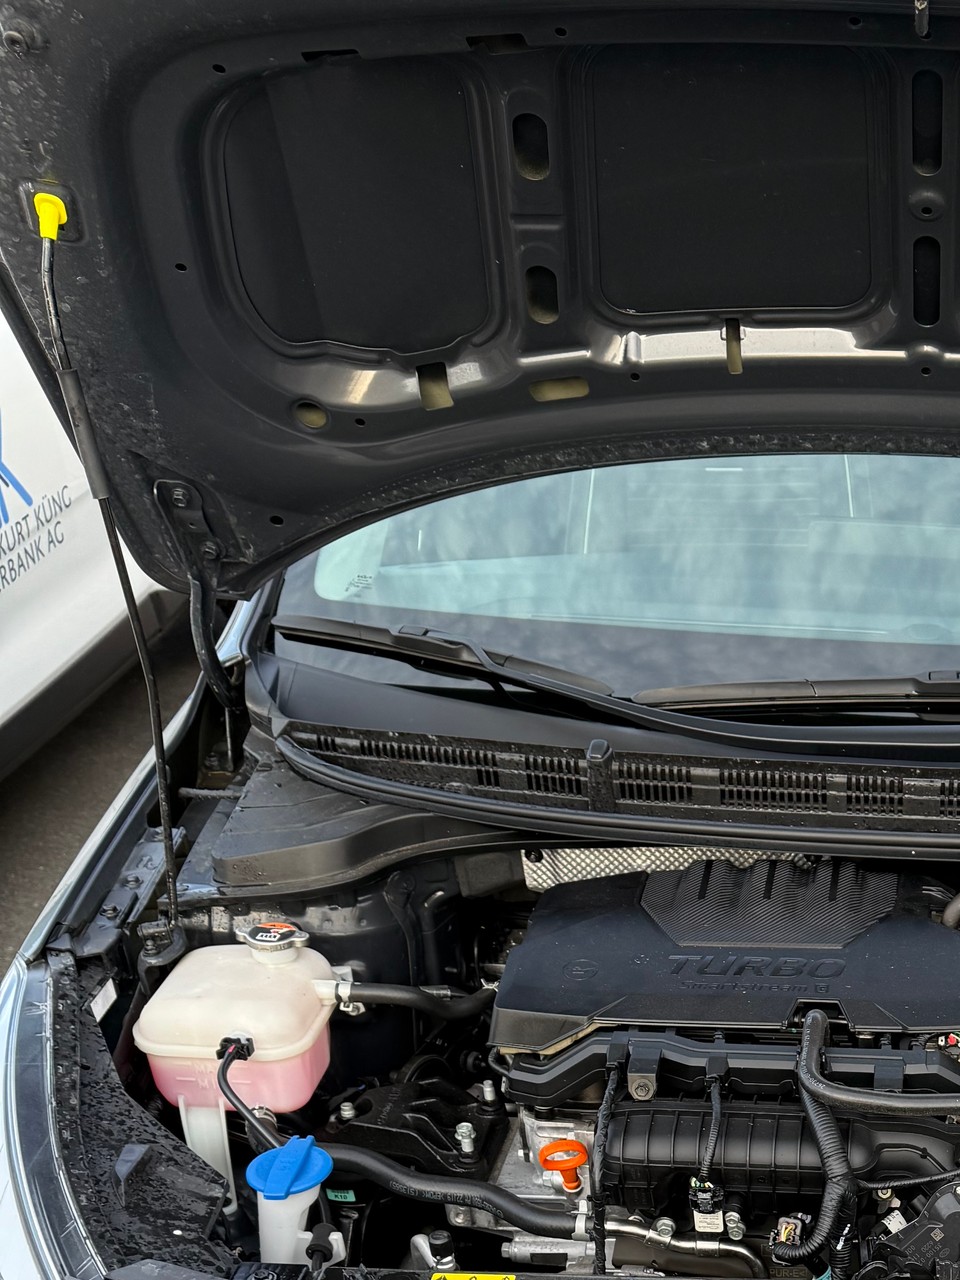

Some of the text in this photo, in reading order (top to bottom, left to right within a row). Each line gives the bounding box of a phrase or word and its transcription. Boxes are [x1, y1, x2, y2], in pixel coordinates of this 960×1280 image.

[34, 485, 72, 531] KÜNG
[0, 521, 64, 592] RBANK AG
[668, 955, 848, 979] TURBO
